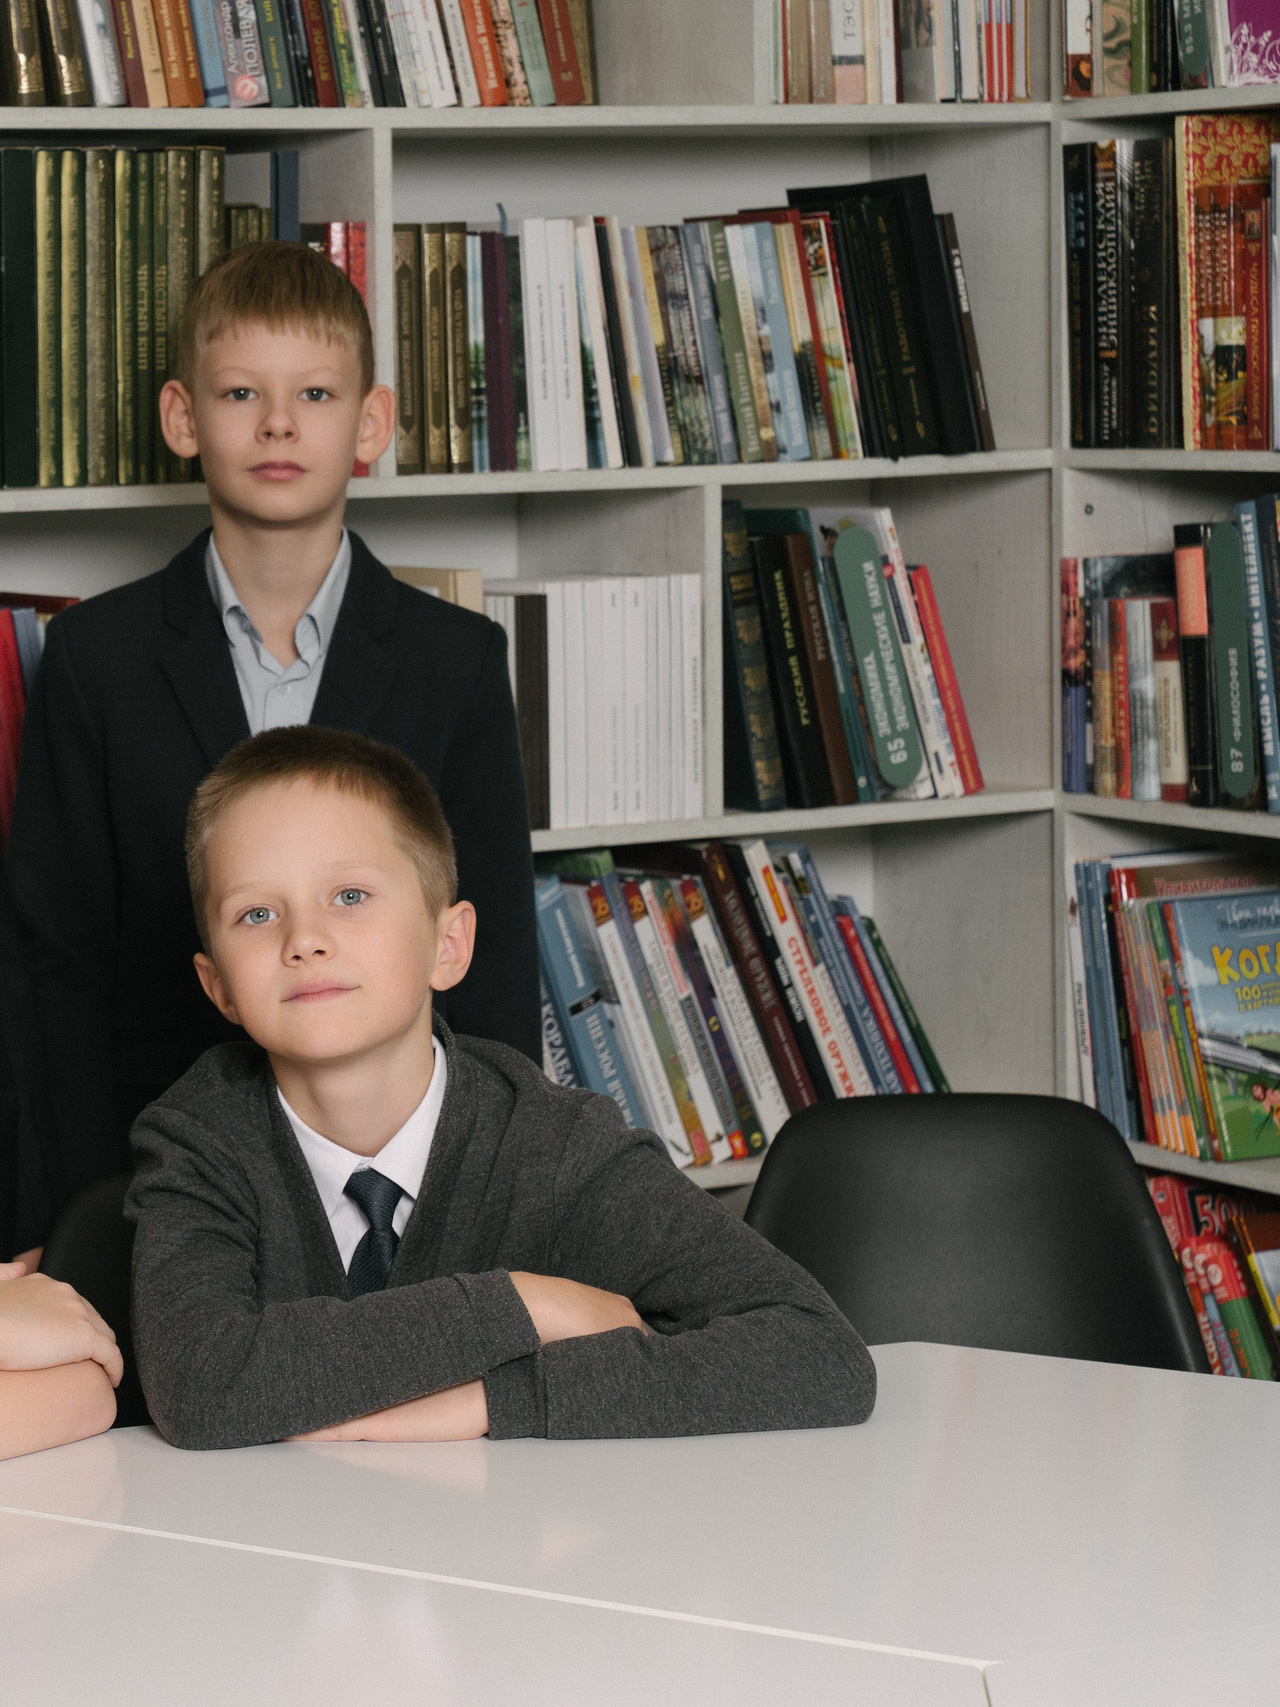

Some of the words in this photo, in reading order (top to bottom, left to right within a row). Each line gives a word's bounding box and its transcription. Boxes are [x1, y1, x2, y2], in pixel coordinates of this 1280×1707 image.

[1102, 181, 1118, 343] ЭНЦИКЛОПЕДИЯ
[1252, 622, 1268, 680] РАЗУМ
[1228, 647, 1242, 741] ФИЛОСОФИЯ
[887, 737, 908, 764] 65
[1260, 693, 1278, 757] МЫСЛЬ
[1231, 747, 1243, 772] 87
